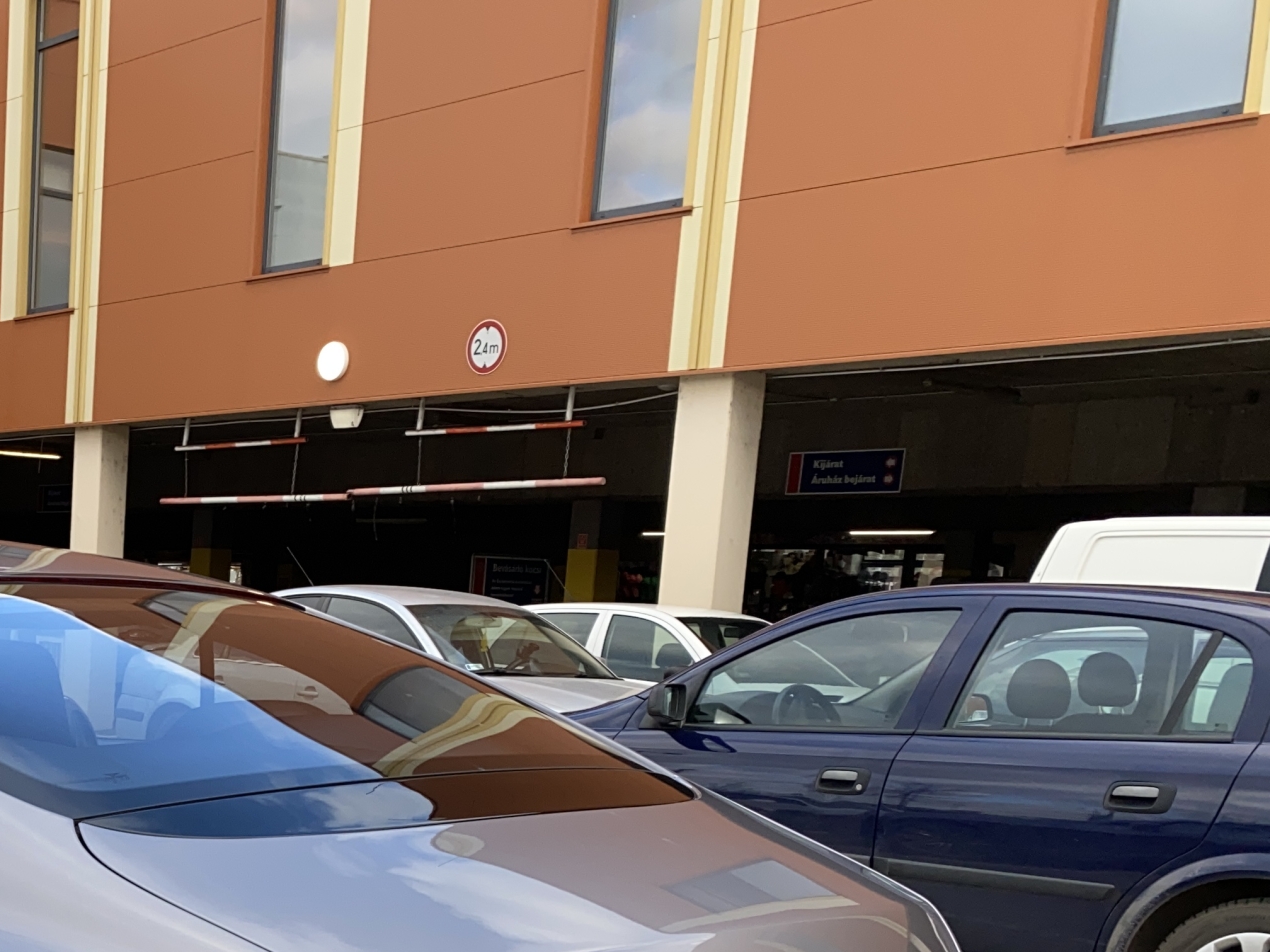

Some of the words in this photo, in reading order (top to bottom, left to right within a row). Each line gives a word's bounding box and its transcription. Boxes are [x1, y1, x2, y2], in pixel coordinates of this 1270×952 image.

[473, 339, 487, 355] 2,4
[489, 344, 499, 354] m
[813, 460, 844, 471] Kijárat
[811, 474, 843, 485] Áruház
[844, 475, 876, 486] bejárat
